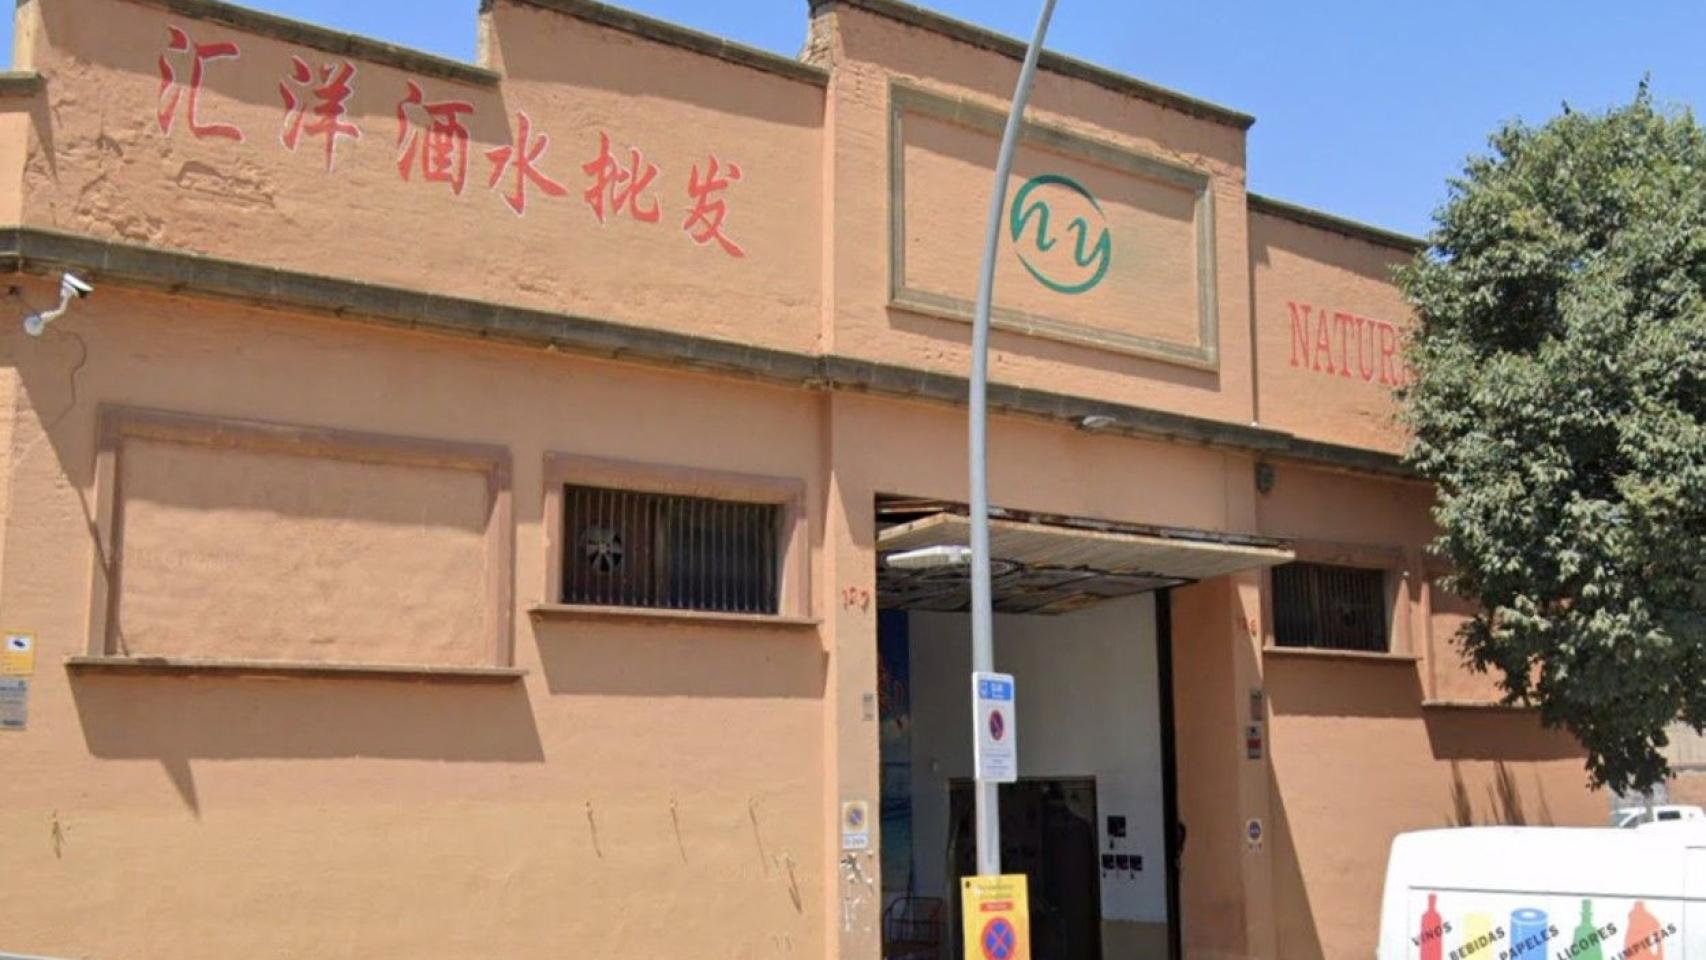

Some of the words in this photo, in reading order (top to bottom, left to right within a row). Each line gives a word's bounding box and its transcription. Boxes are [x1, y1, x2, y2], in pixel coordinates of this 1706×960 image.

[156, 24, 747, 259] 汇洋酒水批发
[1411, 921, 1453, 946] VINOS
[1449, 926, 1505, 960] BEBIDAS
[1499, 924, 1559, 960] PAPELES
[1556, 922, 1618, 960] LICORES
